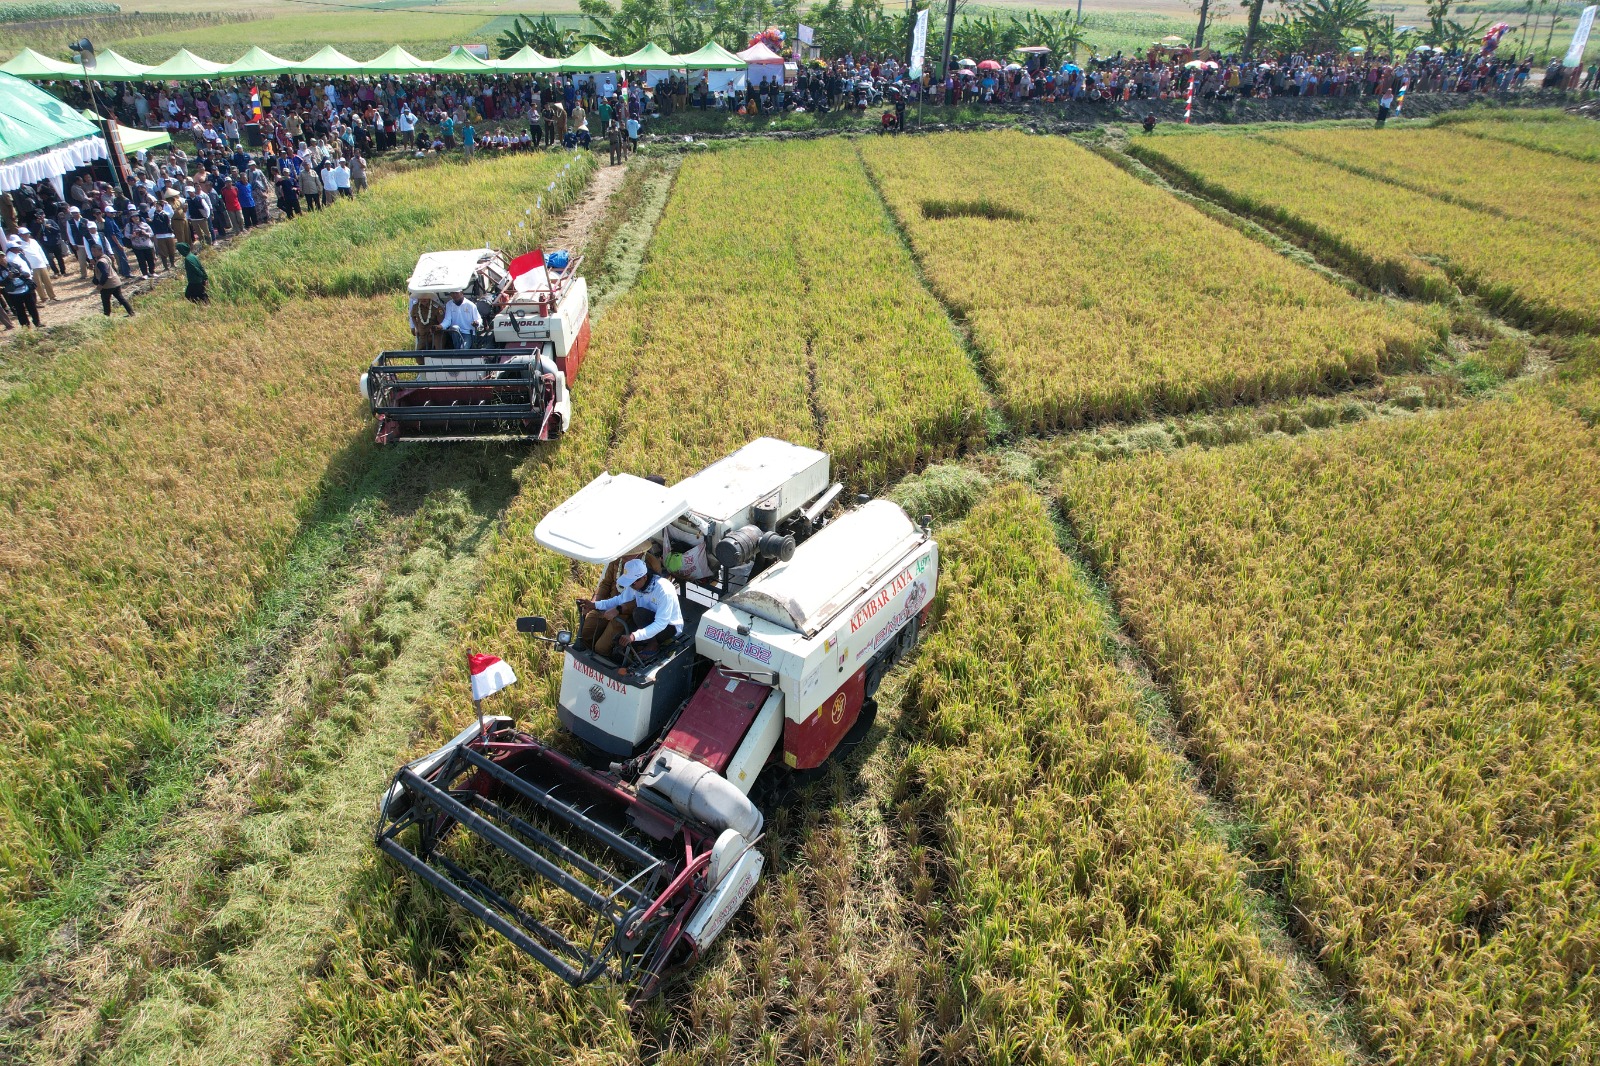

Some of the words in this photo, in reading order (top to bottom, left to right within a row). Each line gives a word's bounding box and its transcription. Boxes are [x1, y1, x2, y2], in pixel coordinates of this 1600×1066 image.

[850, 589, 890, 633] KEMBAR
[891, 569, 913, 596] JAYA
[704, 625, 745, 653] BIMO
[744, 642, 772, 665] 102
[573, 658, 604, 684] KEMBAR
[606, 677, 627, 695] JAYA
